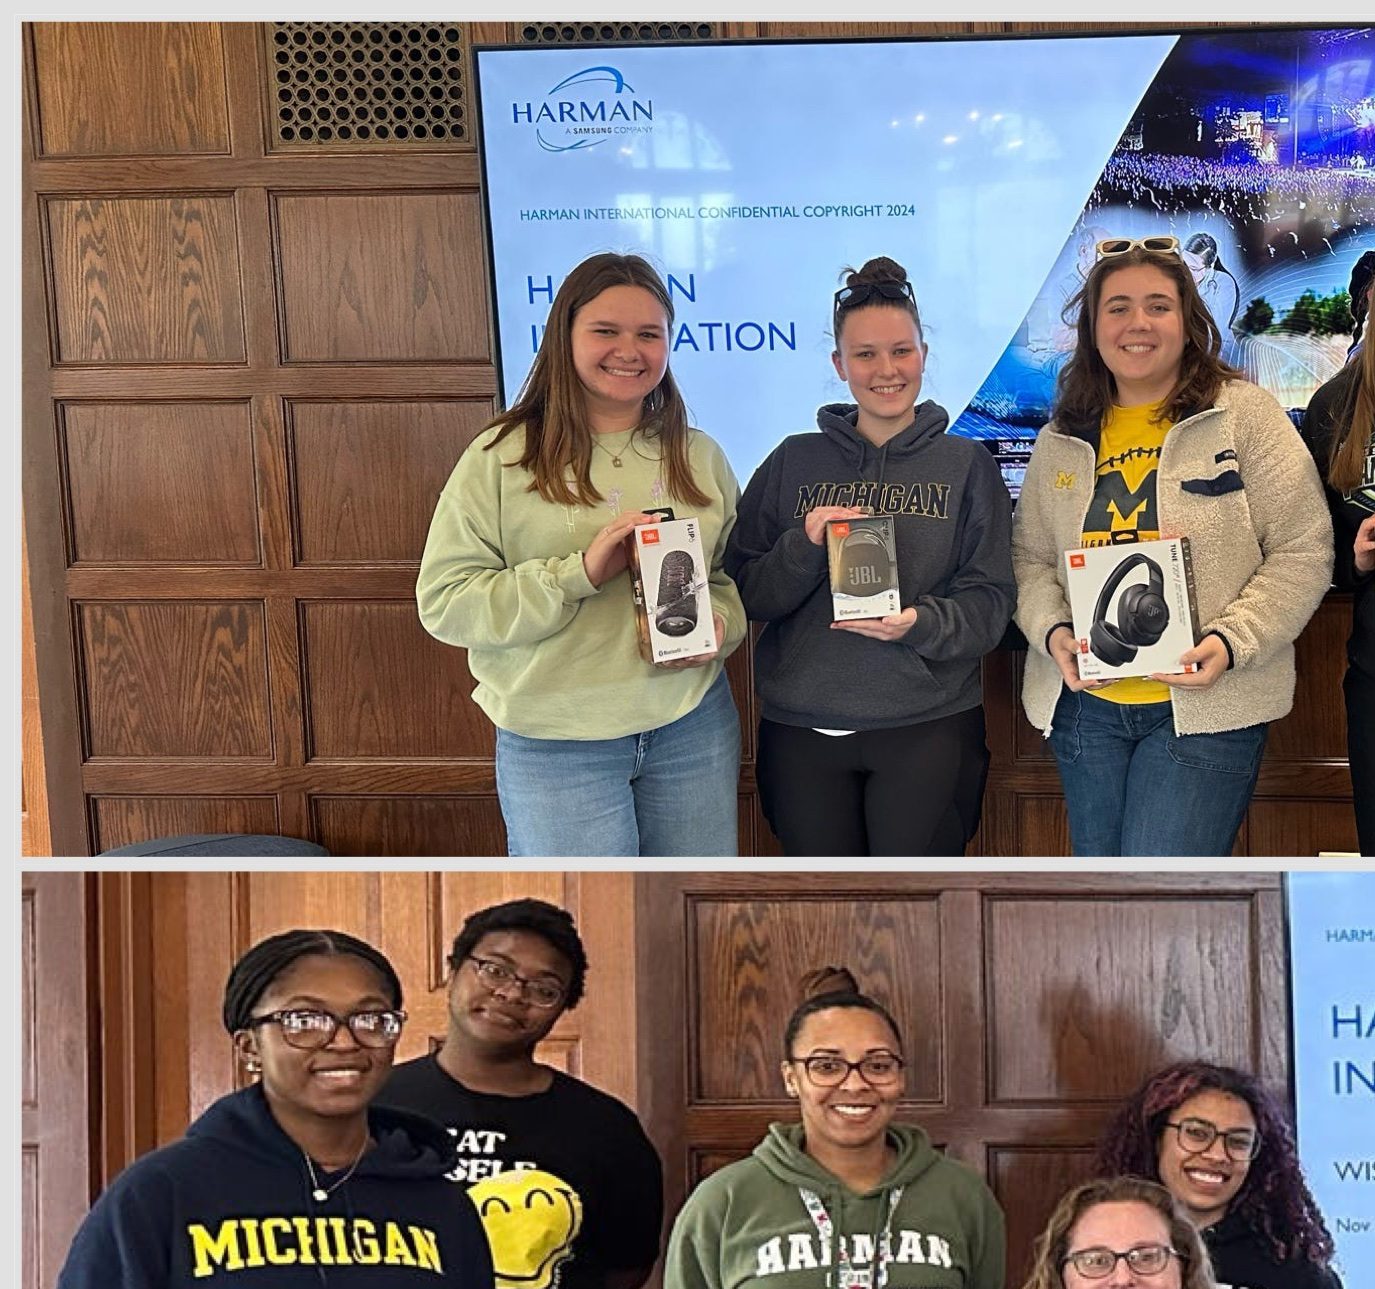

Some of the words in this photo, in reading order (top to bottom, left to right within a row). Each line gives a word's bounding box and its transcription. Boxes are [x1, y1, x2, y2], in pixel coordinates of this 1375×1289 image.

[512, 99, 654, 124] HARMAN
[565, 127, 572, 135] A
[573, 126, 612, 135] SAMSUNG
[613, 125, 654, 134] COMPANY
[519, 209, 580, 221] HARMAN
[583, 207, 695, 220] INTERNATIONAL
[698, 206, 799, 219] CONFIDENTIAL
[802, 205, 883, 218] COPYRIGHT
[886, 204, 916, 217] 2024
[1055, 471, 1077, 490] M
[793, 481, 951, 519] MICHIGAN
[1082, 469, 1160, 533] M
[1336, 1218, 1370, 1233] Nov
[188, 1217, 444, 1278] MICHIGAN
